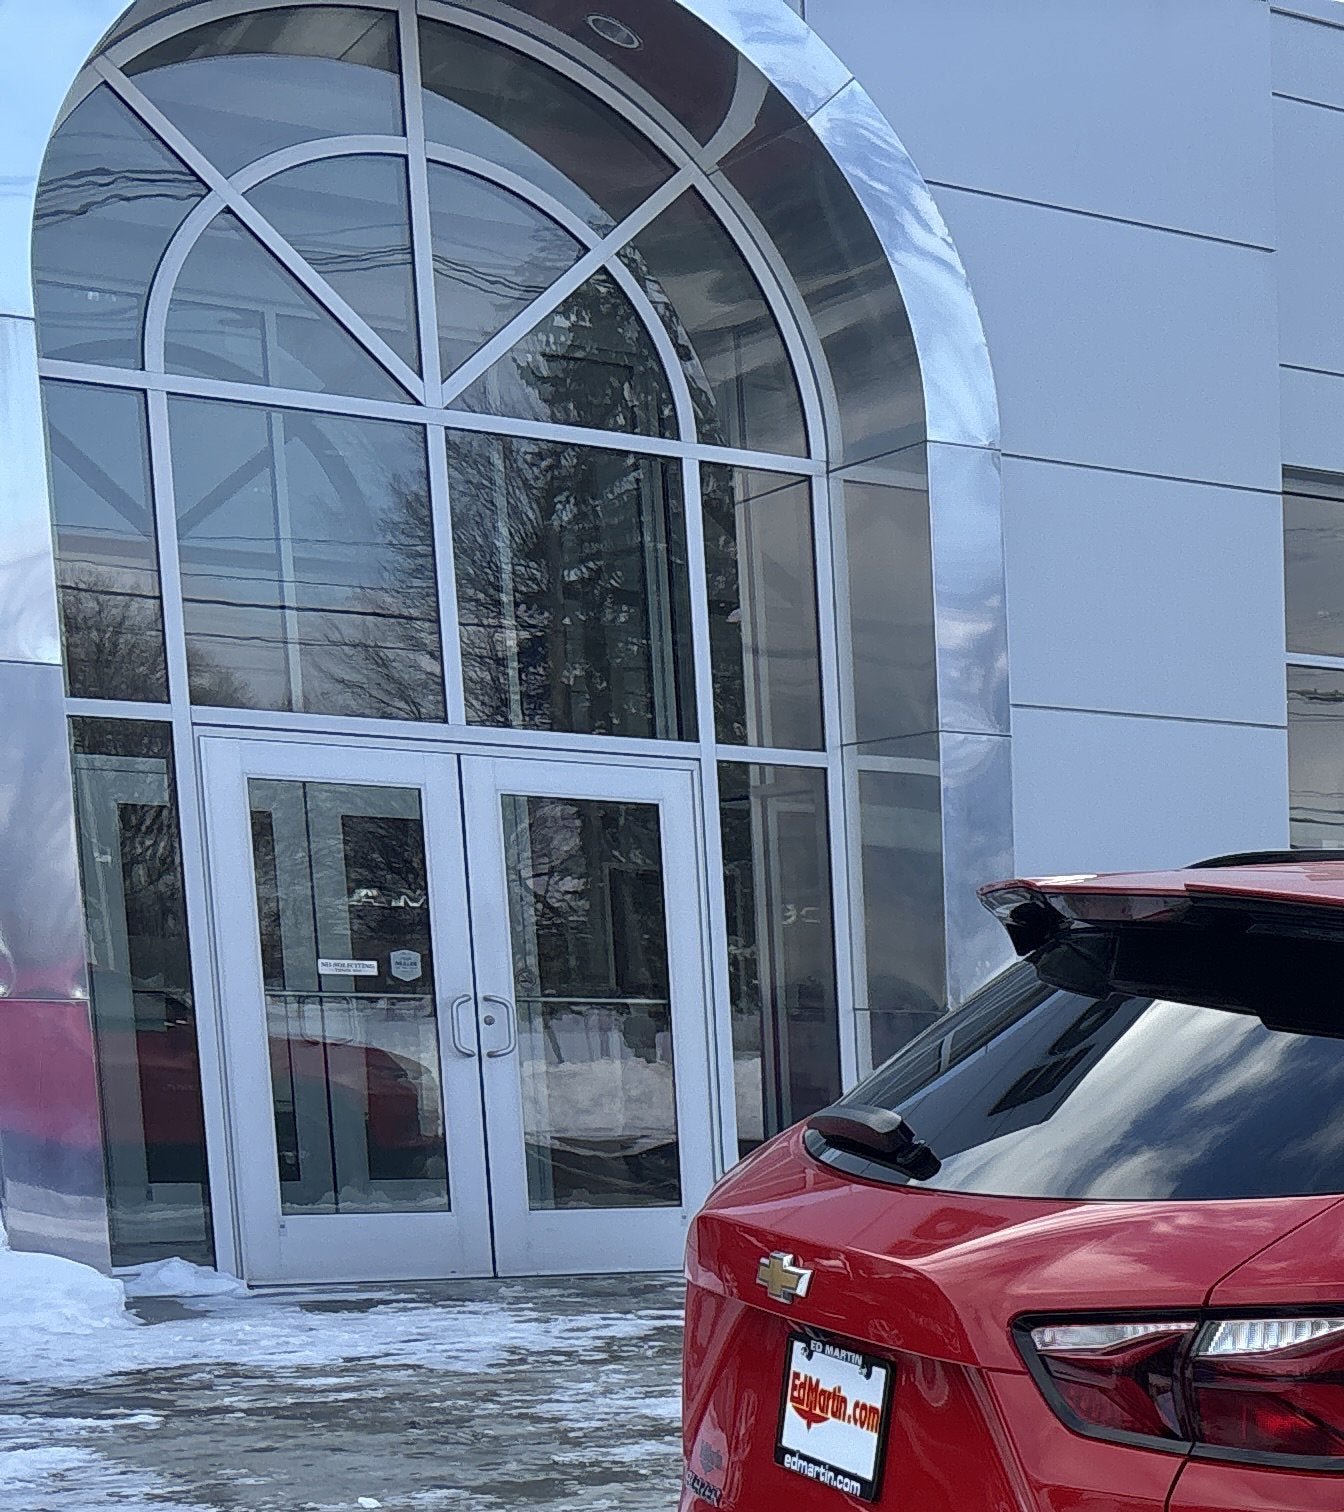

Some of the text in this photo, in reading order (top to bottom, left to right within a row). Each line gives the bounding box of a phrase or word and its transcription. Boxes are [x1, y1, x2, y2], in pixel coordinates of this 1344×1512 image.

[810, 1339, 863, 1366] ED MARTIN
[789, 1370, 880, 1434] EdMartin.com
[783, 1452, 861, 1497] edmartin.com
